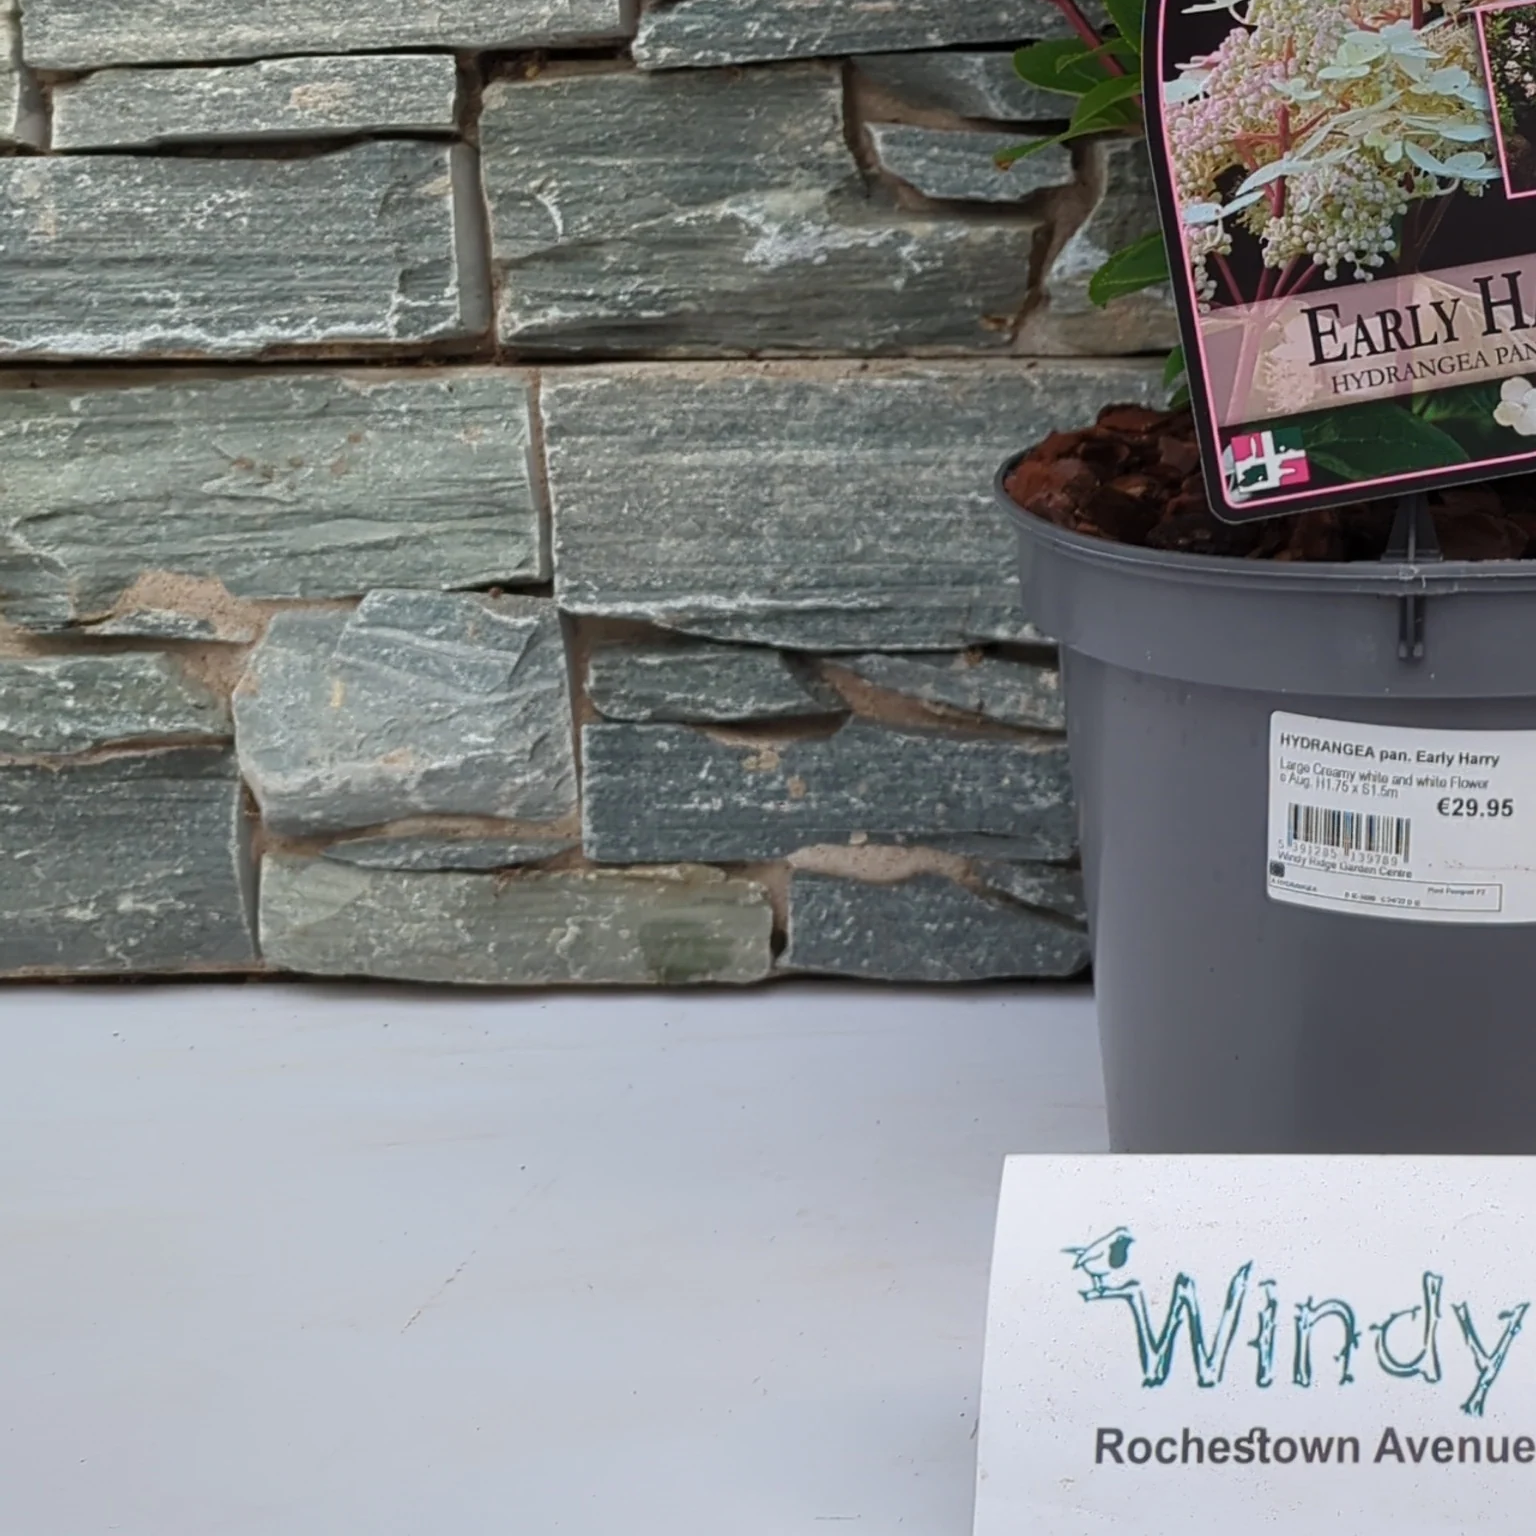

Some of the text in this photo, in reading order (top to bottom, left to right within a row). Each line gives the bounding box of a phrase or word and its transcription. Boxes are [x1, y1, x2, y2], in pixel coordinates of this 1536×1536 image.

[1301, 297, 1461, 366] EARLY
[1331, 352, 1490, 395] HYDRANGEA
[1280, 732, 1500, 767] HYDRANGEA pan. Early Harry
[1280, 756, 1489, 789] Large Creamy white and white Flower
[1436, 797, 1514, 817] €29.95
[1278, 850, 1306, 867] Windy
[1339, 861, 1377, 875] Garden
[1379, 866, 1413, 879] Centre
[1095, 1425, 1360, 1465] Rochestown
